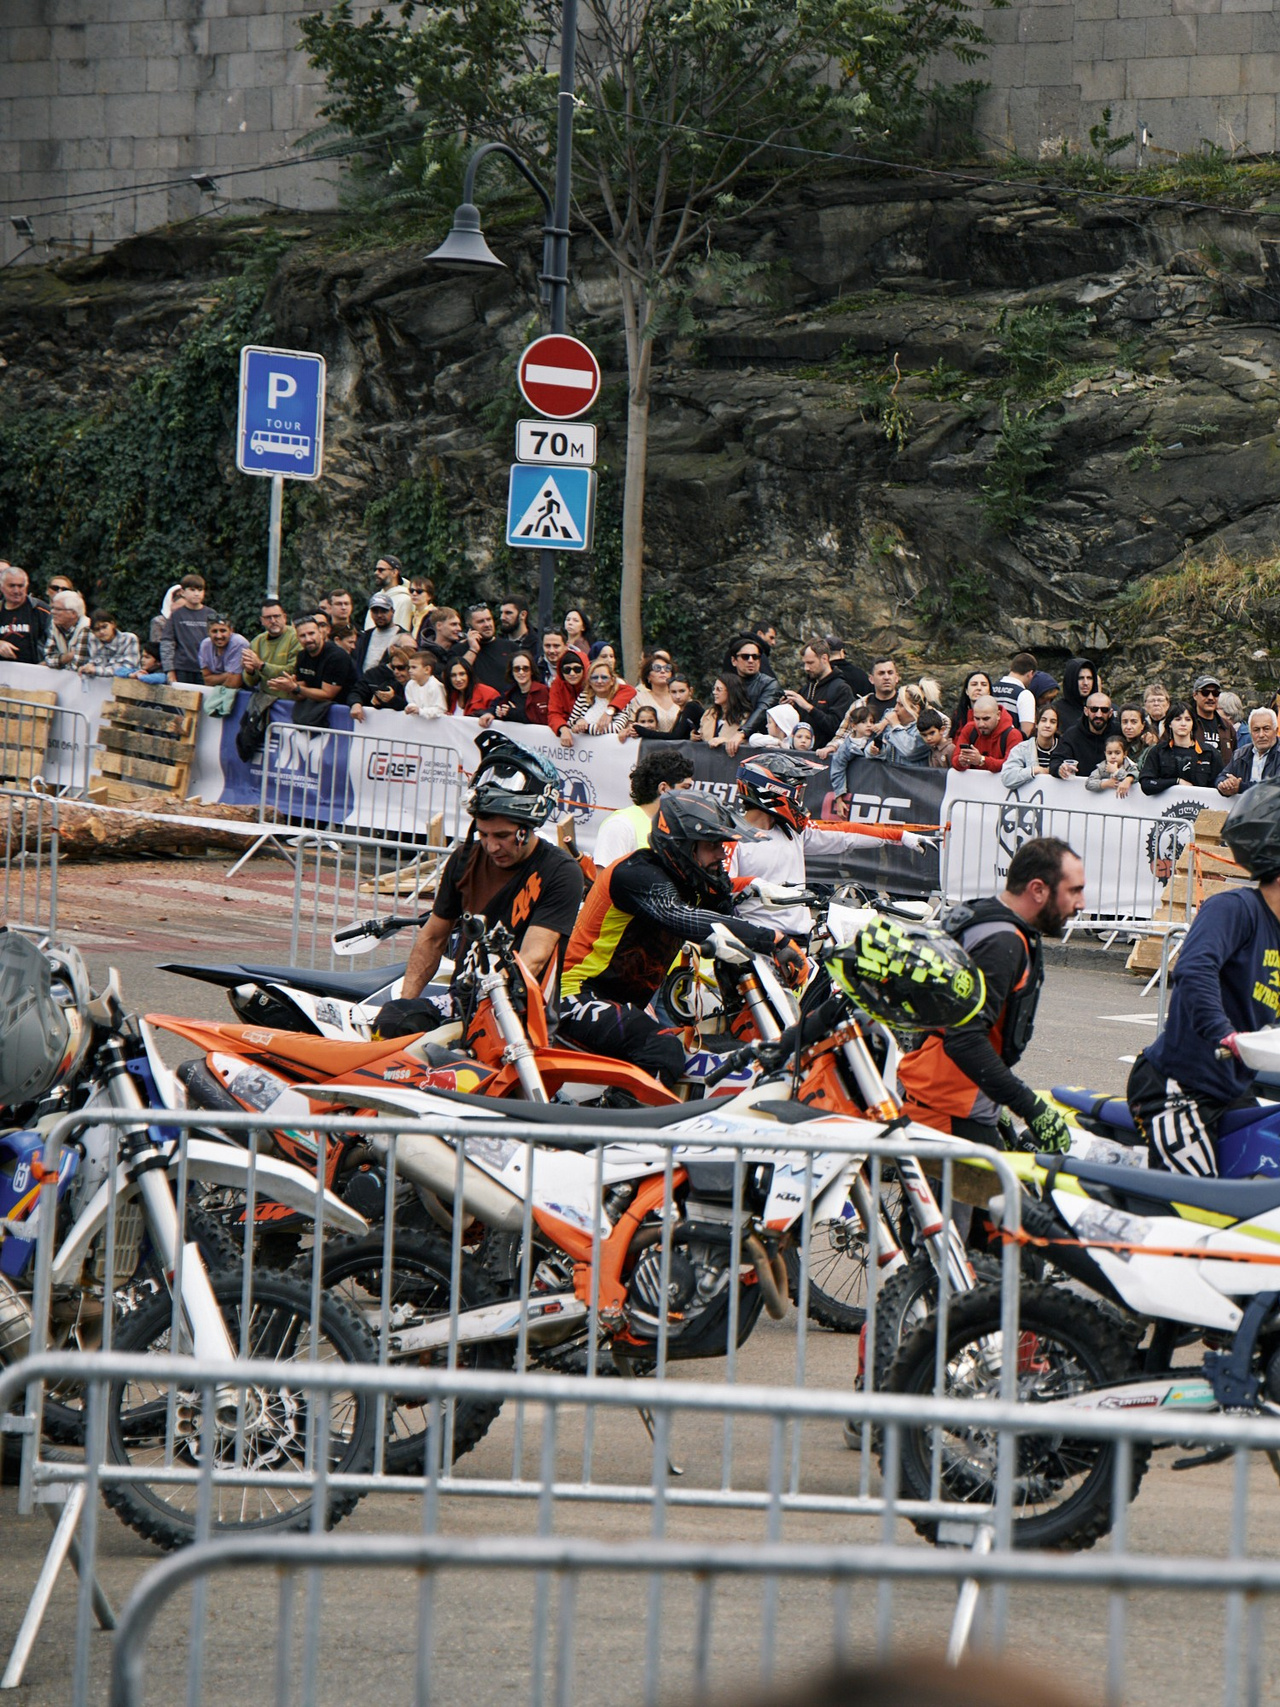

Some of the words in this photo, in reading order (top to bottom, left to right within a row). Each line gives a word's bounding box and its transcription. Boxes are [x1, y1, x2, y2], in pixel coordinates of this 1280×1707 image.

[267, 372, 297, 410] P
[266, 418, 301, 431] TOUR
[578, 750, 594, 762] OF
[776, 1192, 801, 1203] KTM
